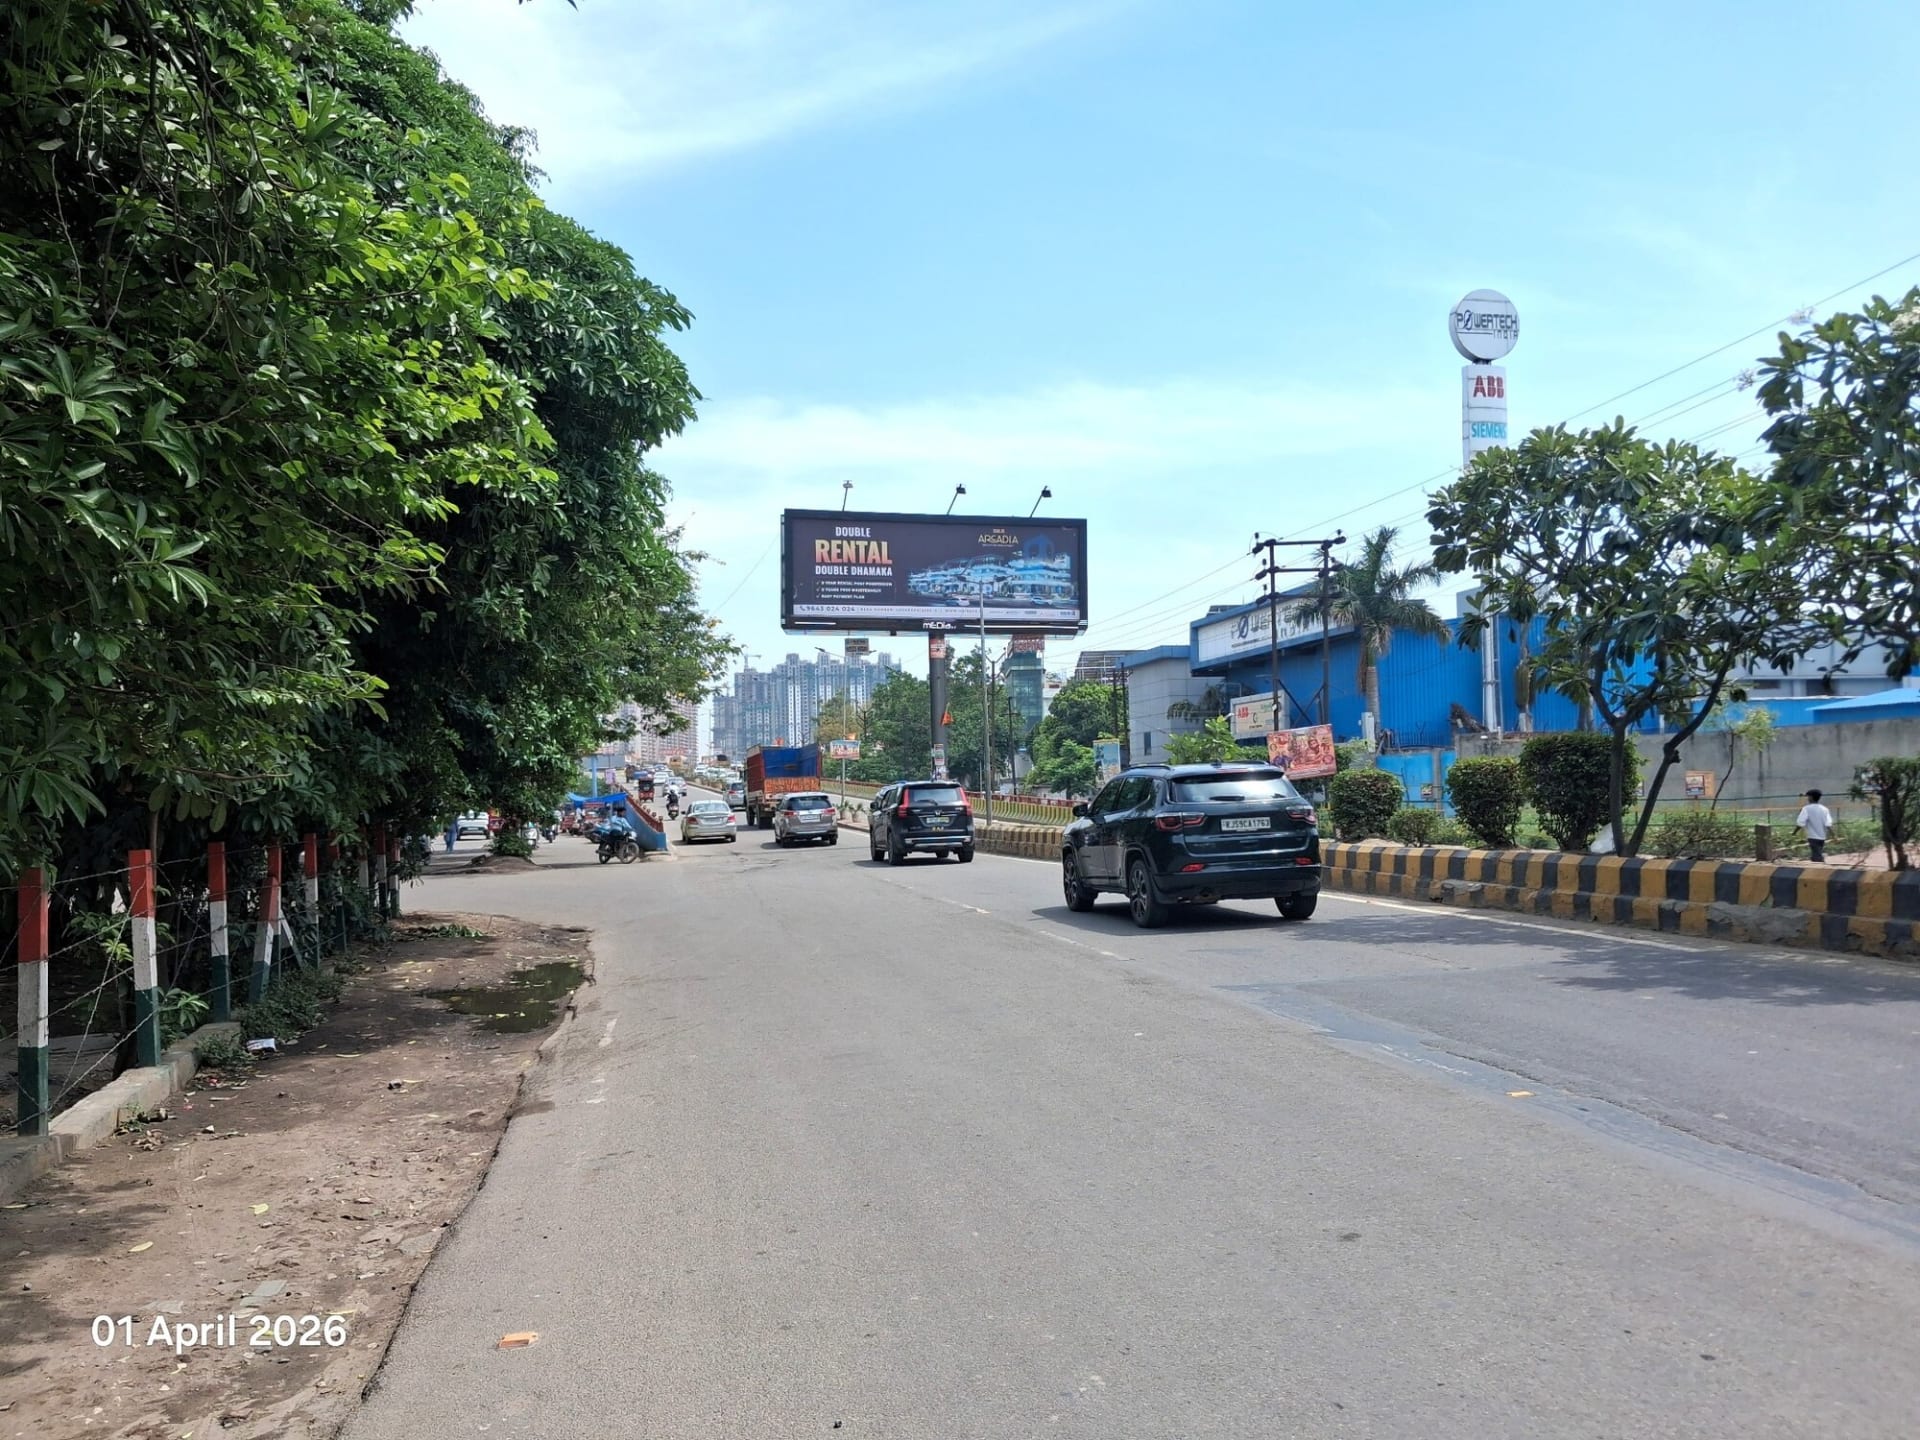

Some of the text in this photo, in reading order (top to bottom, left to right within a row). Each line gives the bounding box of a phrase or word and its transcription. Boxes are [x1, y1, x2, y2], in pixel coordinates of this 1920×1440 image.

[1473, 375, 1504, 398] ABB
[1471, 422, 1507, 439] SIEMENS
[835, 526, 871, 538] DOUBLE
[815, 539, 892, 564] RENTAL
[815, 565, 892, 576] DOUBLE DHAMAKA
